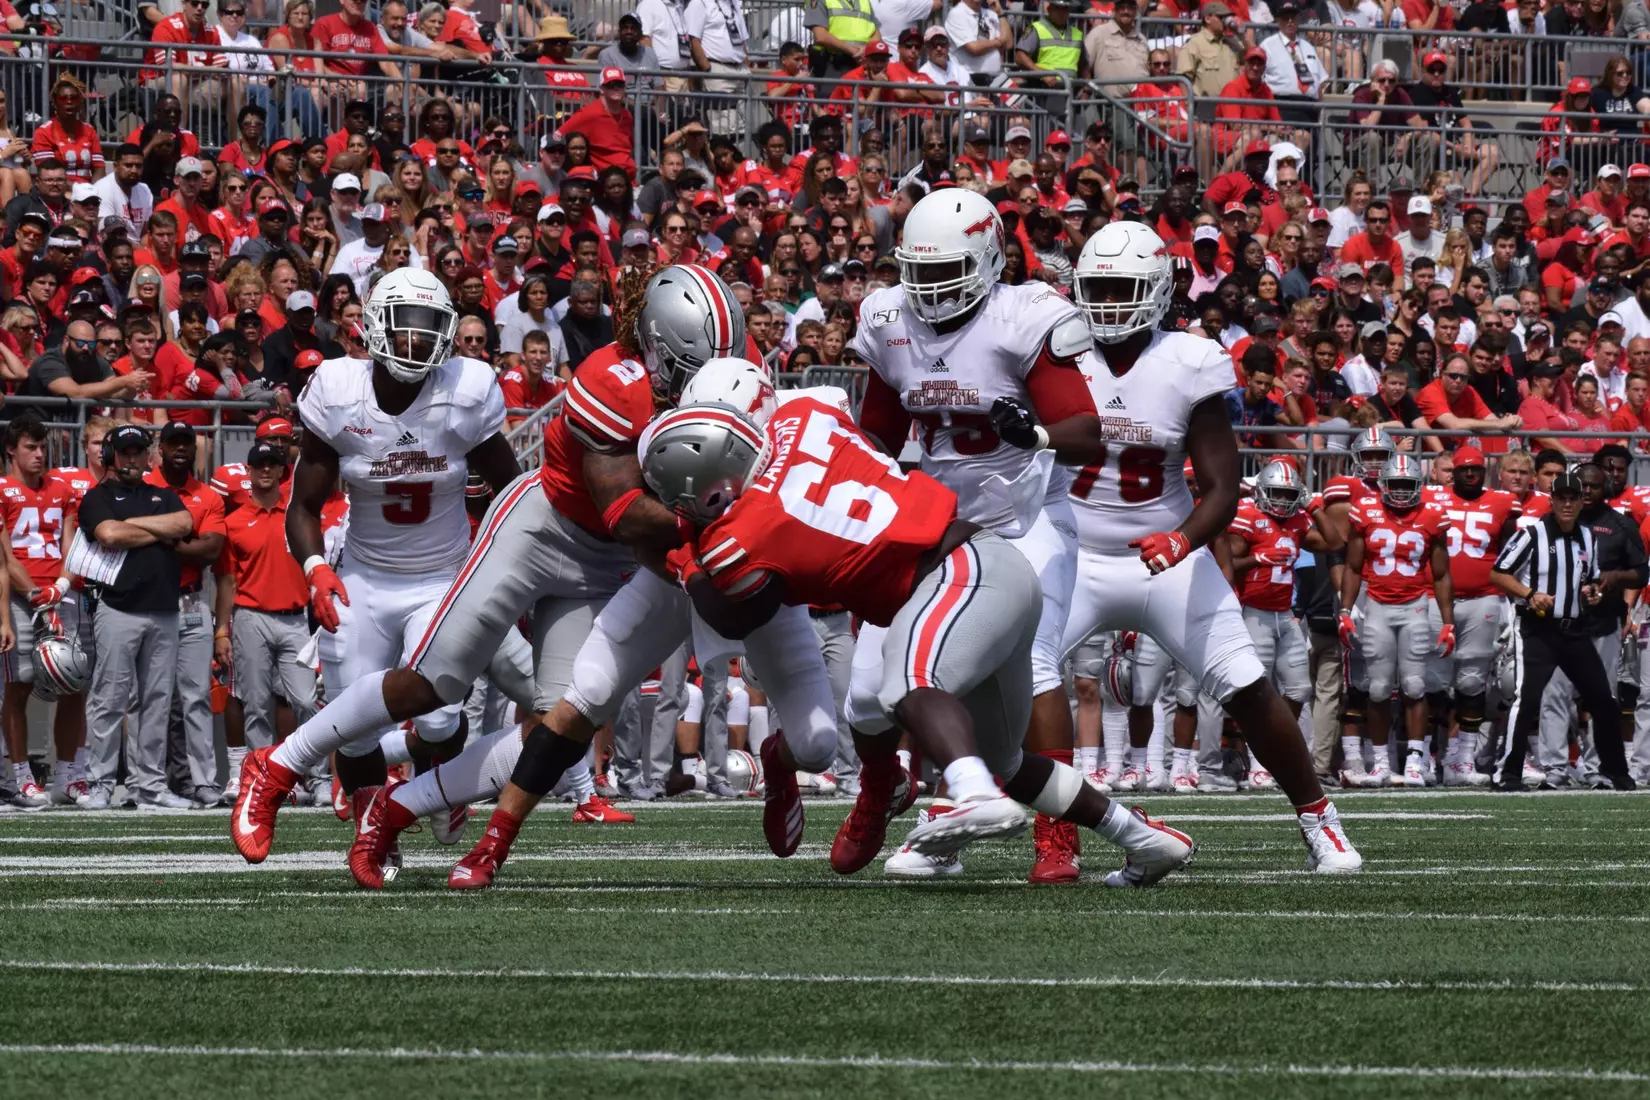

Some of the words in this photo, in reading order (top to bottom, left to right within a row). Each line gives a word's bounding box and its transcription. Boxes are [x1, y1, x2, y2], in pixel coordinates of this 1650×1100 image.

[1606, 98, 1633, 113] USA
[416, 293, 433, 301] OWLS
[872, 308, 900, 326] 150
[887, 338, 912, 347] C-USA
[607, 359, 646, 387] 2
[921, 380, 958, 389] FLORIDA
[907, 388, 979, 406] ATLANTIC
[395, 438, 419, 447] adidas
[751, 416, 801, 494] LANDERS
[369, 455, 449, 476] ATLANTIC
[777, 409, 910, 546] 67
[1446, 509, 1493, 559] 55
[1369, 528, 1425, 577] 33
[1549, 545, 1556, 554] S
